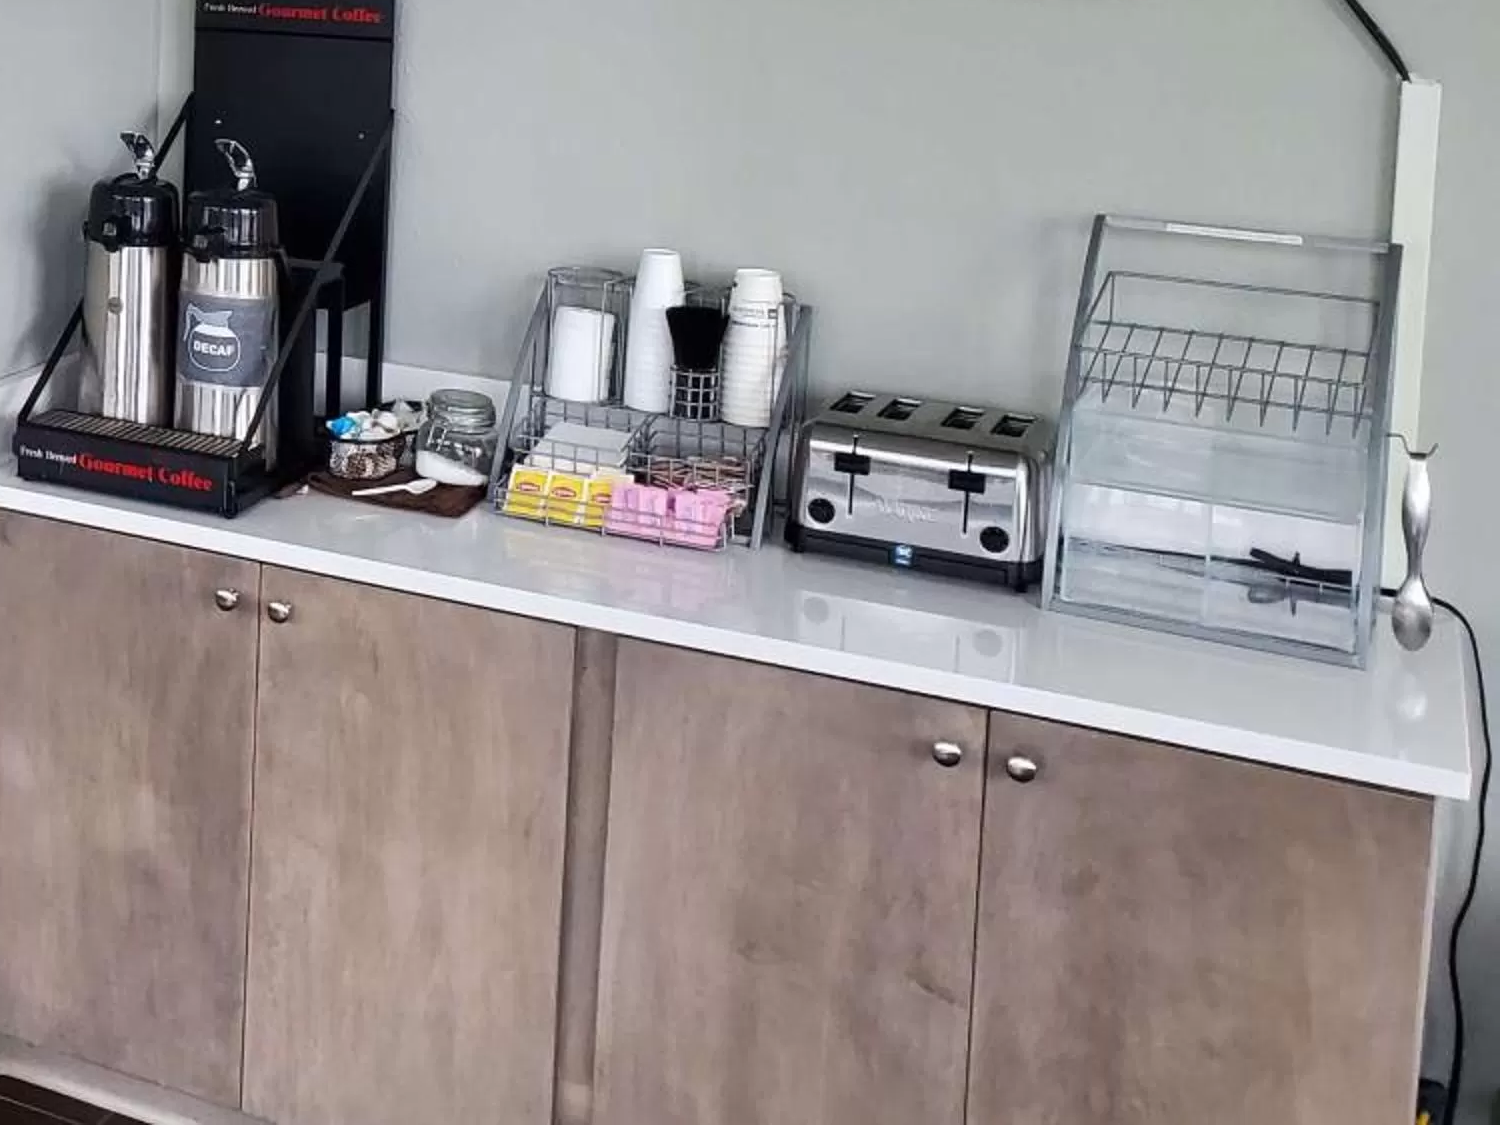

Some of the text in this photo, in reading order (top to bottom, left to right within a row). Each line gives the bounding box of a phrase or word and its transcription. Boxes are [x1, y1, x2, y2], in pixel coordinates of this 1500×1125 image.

[258, 3, 326, 21] Gourmet
[333, 6, 381, 24] Coffee
[193, 339, 235, 356] DECAF
[19, 445, 44, 459] Fresh
[78, 452, 154, 482] Gourmet
[157, 468, 213, 491] Coffee
